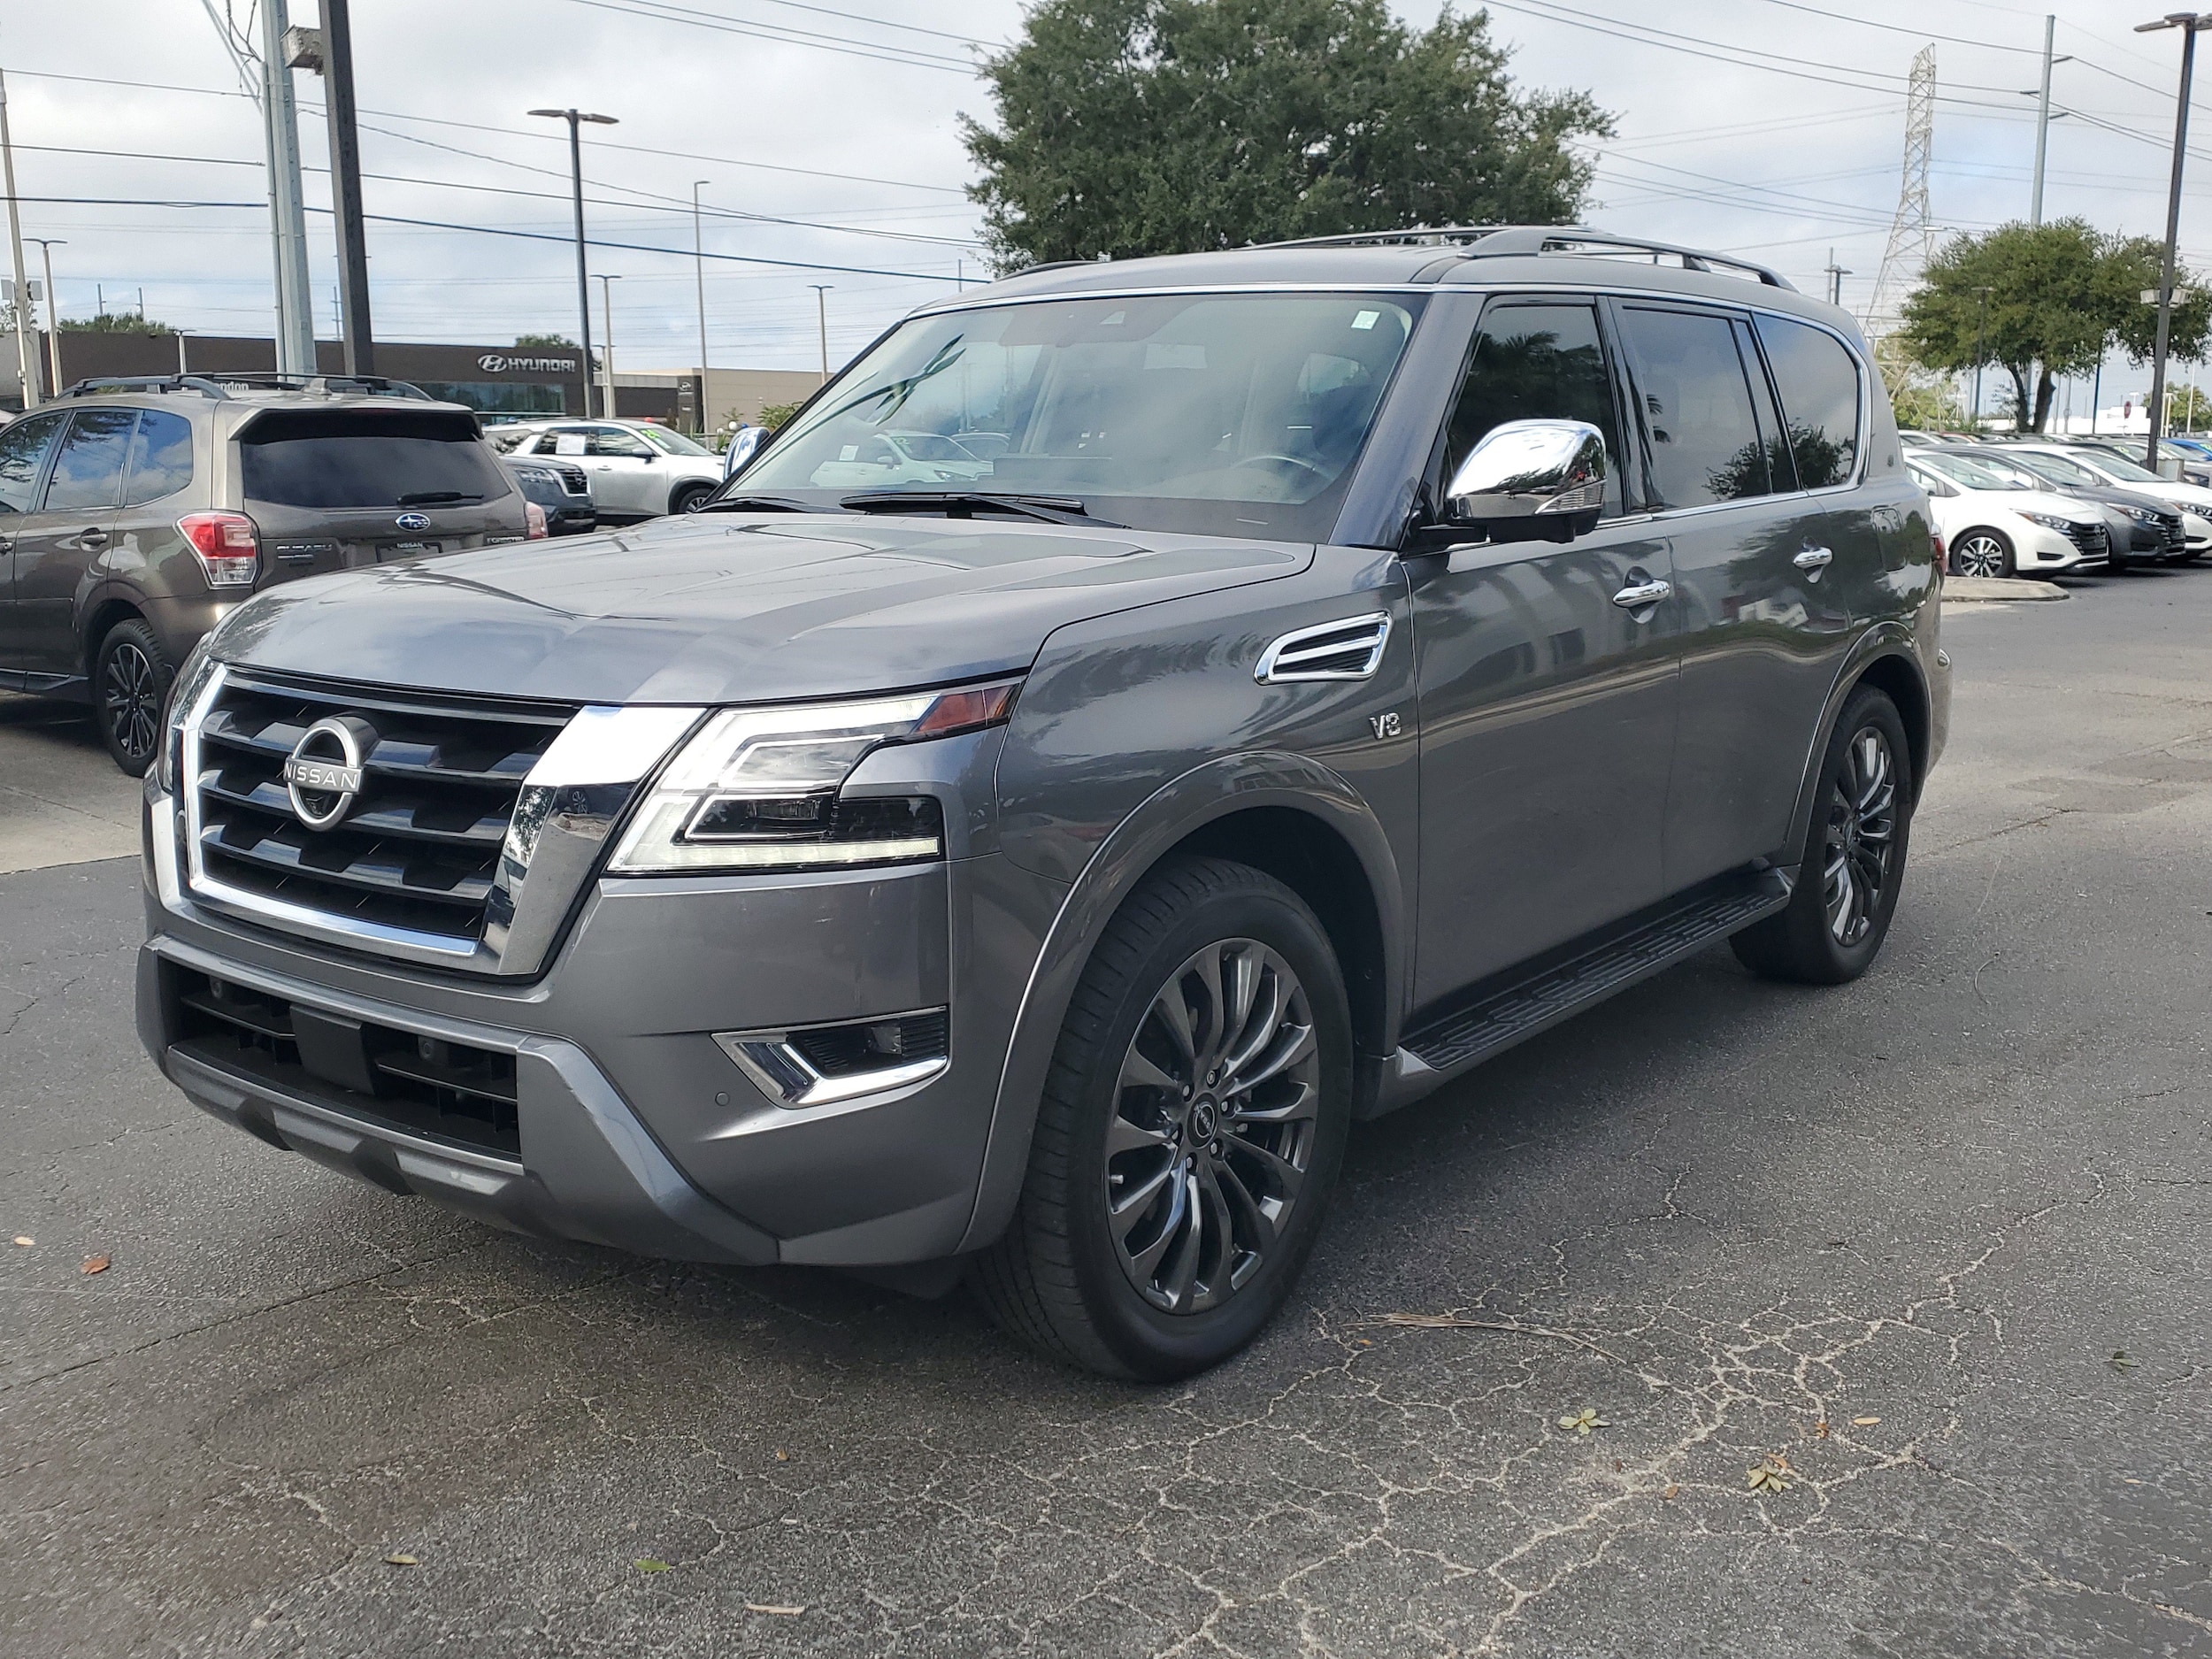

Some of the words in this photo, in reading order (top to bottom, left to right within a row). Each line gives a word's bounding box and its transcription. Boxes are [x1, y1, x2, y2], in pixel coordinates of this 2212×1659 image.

[508, 357, 575, 372] HYUNDAI
[1369, 712, 1402, 739] V8
[284, 762, 357, 789] NISSAN
